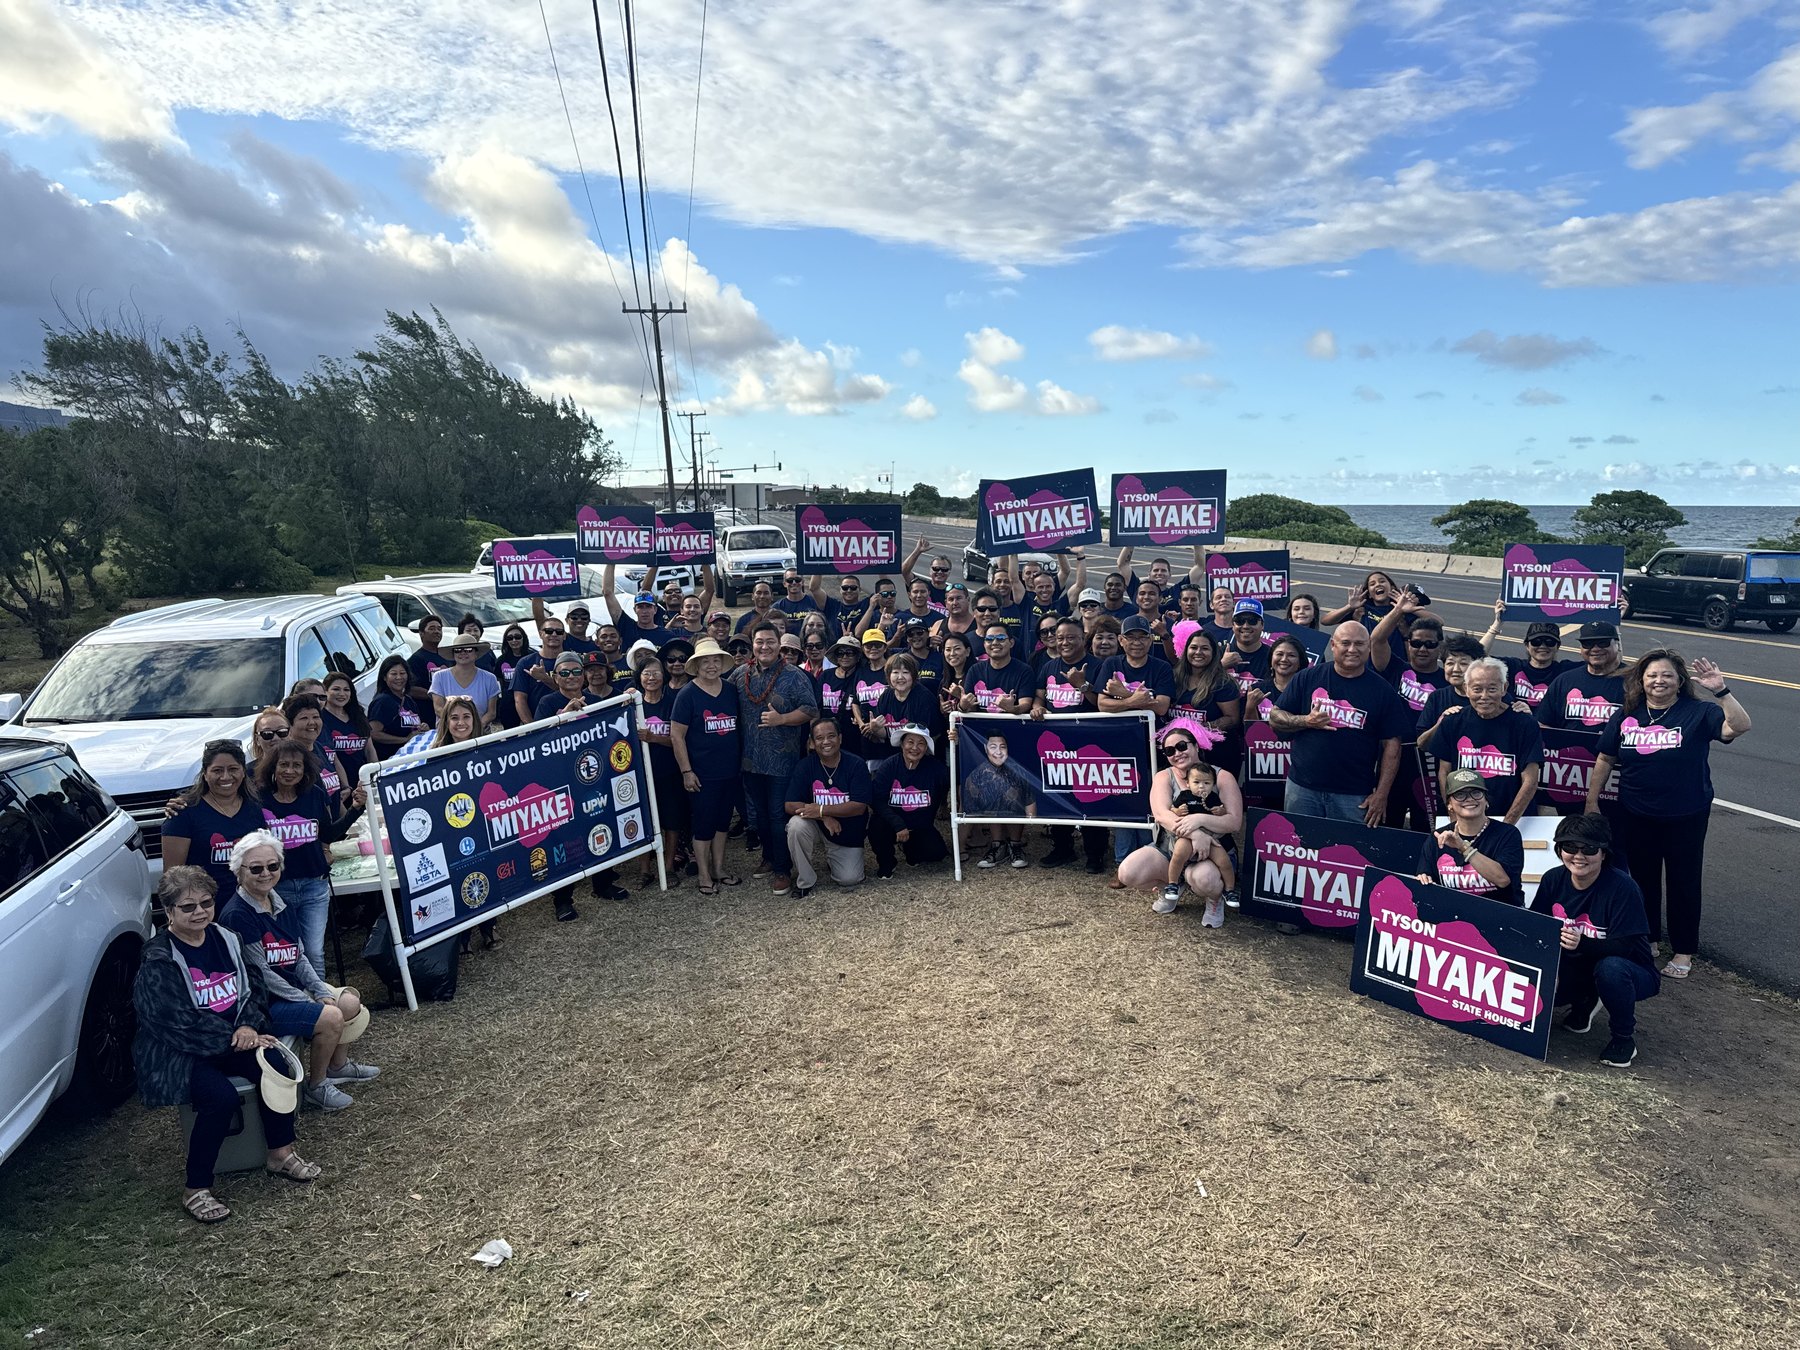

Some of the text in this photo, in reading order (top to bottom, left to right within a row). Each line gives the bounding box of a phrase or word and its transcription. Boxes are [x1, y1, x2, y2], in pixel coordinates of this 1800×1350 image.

[993, 498, 1029, 511] TYSON
[1123, 493, 1158, 502] TYSON
[583, 520, 610, 528] TYSON
[996, 503, 1087, 537] MIYAKE
[1123, 503, 1212, 529] MIYAKE
[807, 524, 840, 533] TYSON
[1046, 528, 1086, 539] STATE HOUSE
[584, 530, 650, 548] MIYAKE
[656, 534, 710, 552] MIYAKE
[809, 536, 890, 558] MIYAKE
[500, 555, 528, 563] TYSON
[502, 562, 573, 582] MIYAKE
[1212, 567, 1240, 575] TYSON
[1513, 563, 1551, 573] TYSON
[1512, 575, 1612, 602] MIYAKE
[1585, 602, 1610, 610] HOUSE
[1047, 689, 1081, 702] MIYAKE
[1401, 682, 1429, 704] MIYA
[1516, 684, 1548, 700] MIYA
[707, 718, 736, 731] MIYAKE
[335, 739, 366, 749] MIYAKE
[1254, 740, 1291, 750] TYSON
[1623, 730, 1678, 746] MIYAKE
[384, 766, 462, 806] Mahalo
[466, 756, 492, 781] for
[497, 746, 536, 775] your
[540, 720, 608, 760] support!
[1044, 750, 1078, 760] TYSON
[1461, 754, 1512, 771] MIYAKE
[1046, 763, 1133, 787] MIYAKE
[890, 793, 928, 805] MIYAKE
[1572, 789, 1619, 801] STAT OUSE
[487, 795, 520, 814] TYSON
[582, 794, 608, 814] UPW
[266, 818, 286, 826] YSON
[491, 792, 569, 842] MIYAKE
[537, 818, 569, 835] STATE HOUSE
[1265, 841, 1319, 862] TYSON
[415, 869, 442, 885] HSTA
[1380, 908, 1437, 939] TYSON
[1375, 930, 1530, 1017] MIYAKE
[1451, 999, 1522, 1031] STATE HOUSE
